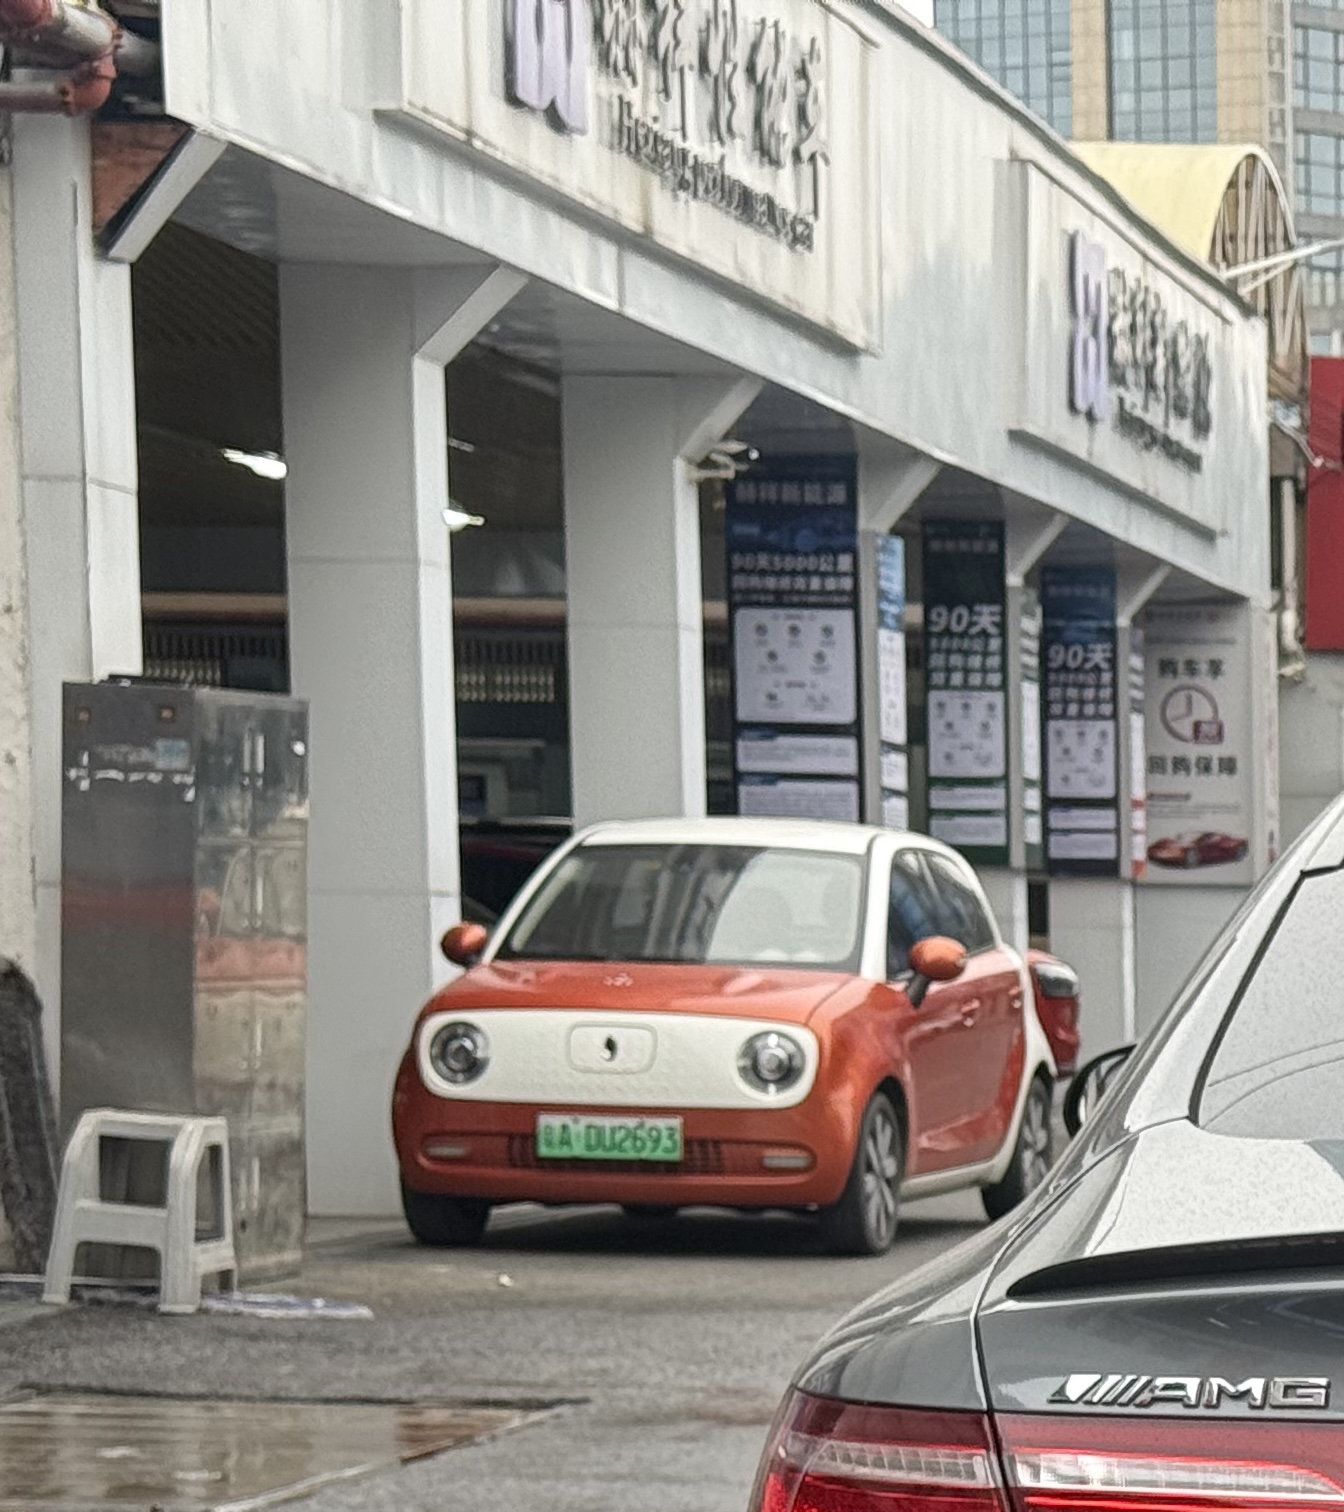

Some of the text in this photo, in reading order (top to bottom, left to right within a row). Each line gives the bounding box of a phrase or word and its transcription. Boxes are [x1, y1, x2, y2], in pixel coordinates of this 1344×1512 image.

[928, 604, 1003, 634] 90天
[1048, 643, 1114, 670] 90天
[1157, 658, 1225, 681] 购车享
[1150, 755, 1238, 777] 回购保障
